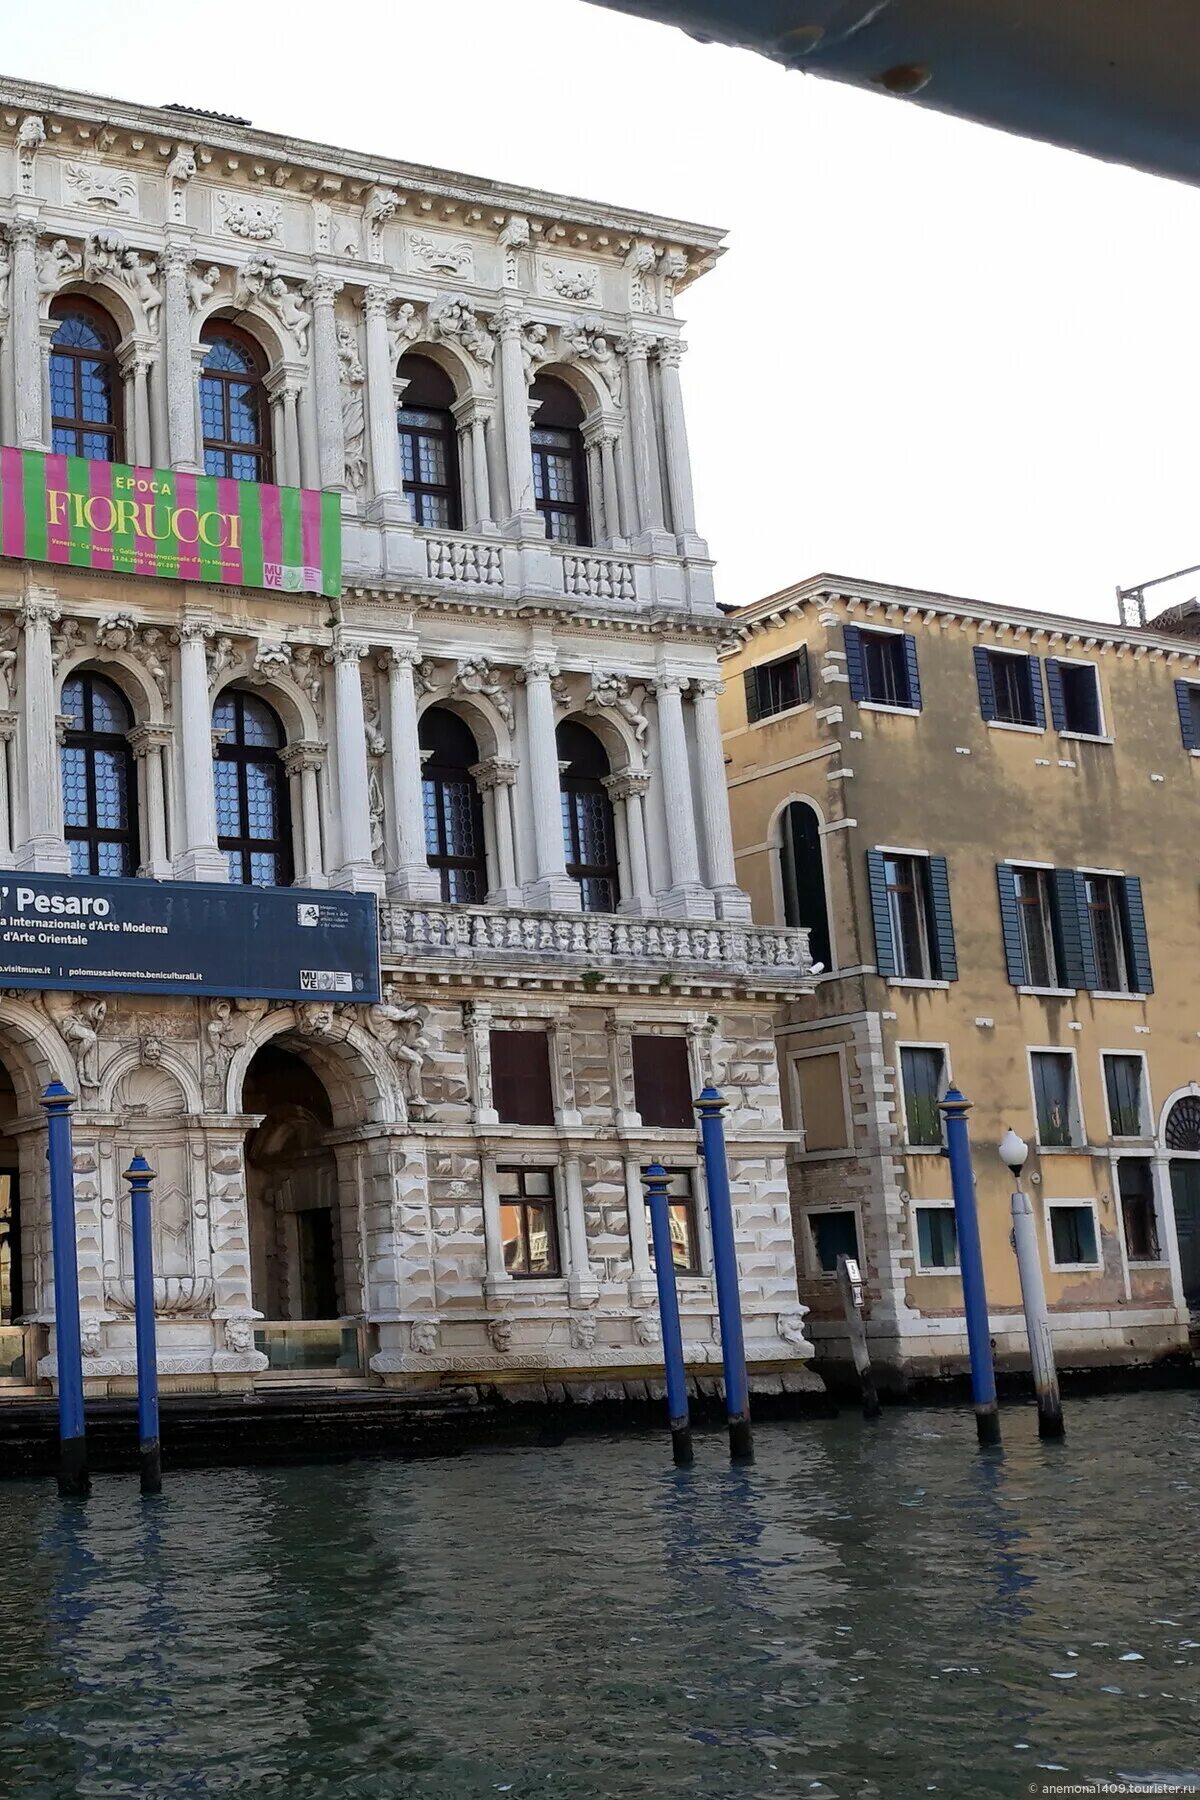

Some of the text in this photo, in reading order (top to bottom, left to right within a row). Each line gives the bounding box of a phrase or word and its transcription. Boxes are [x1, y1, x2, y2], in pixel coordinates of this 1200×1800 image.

[116, 476, 171, 496] EPOCA
[46, 489, 240, 549] FIORUCCI
[265, 564, 282, 576] MU
[265, 575, 282, 587] VE
[17, 887, 109, 916] Pesaro
[9, 916, 87, 930] Internazionale
[88, 921, 120, 932] d'Arte
[122, 922, 168, 934] Moderna
[3, 931, 36, 943] d'Arte
[38, 933, 88, 945] Orientale
[68, 968, 203, 980] polomusealeveneto.beniculturali.it
[301, 971, 317, 980] MU
[301, 980, 317, 989] VE
